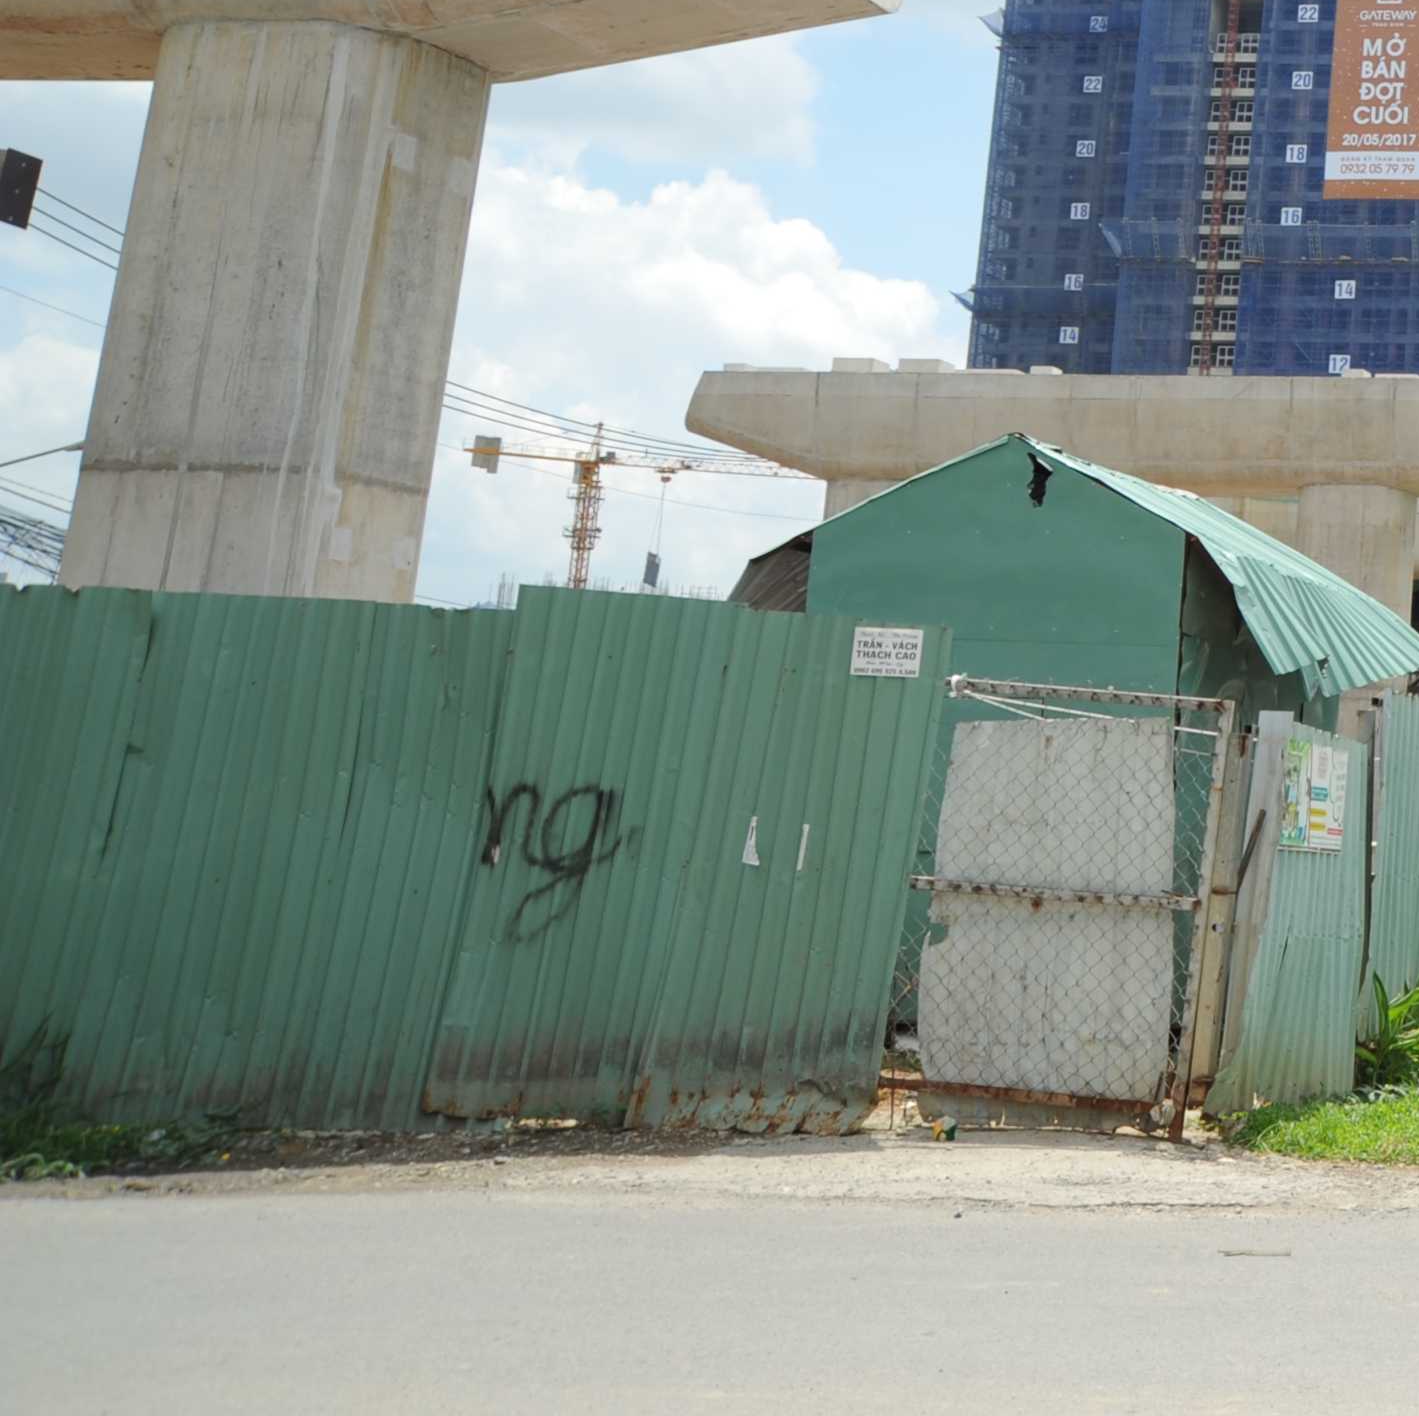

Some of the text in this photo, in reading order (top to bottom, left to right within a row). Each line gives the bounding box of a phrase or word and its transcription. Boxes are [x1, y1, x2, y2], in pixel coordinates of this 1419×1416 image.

[1300, 6, 1317, 20] 22
[1360, 10, 1416, 21] GATEWAY
[1363, 32, 1407, 56] MỞ
[1361, 56, 1406, 79] BÁN
[1084, 78, 1100, 91] 22
[1294, 74, 1311, 88] 20
[1353, 101, 1408, 125] CUỐI
[1342, 134, 1416, 147] 20/05/2017
[1078, 142, 1094, 156] 20
[1288, 146, 1305, 161] 18
[1340, 163, 1366, 174] 0932
[1385, 163, 1400, 174] 79
[1401, 163, 1415, 174] 79
[1072, 204, 1088, 218] 18
[1284, 210, 1300, 224] 16
[1067, 276, 1083, 289] 16
[1337, 282, 1353, 297] 14
[895, 651, 916, 661] CAO
